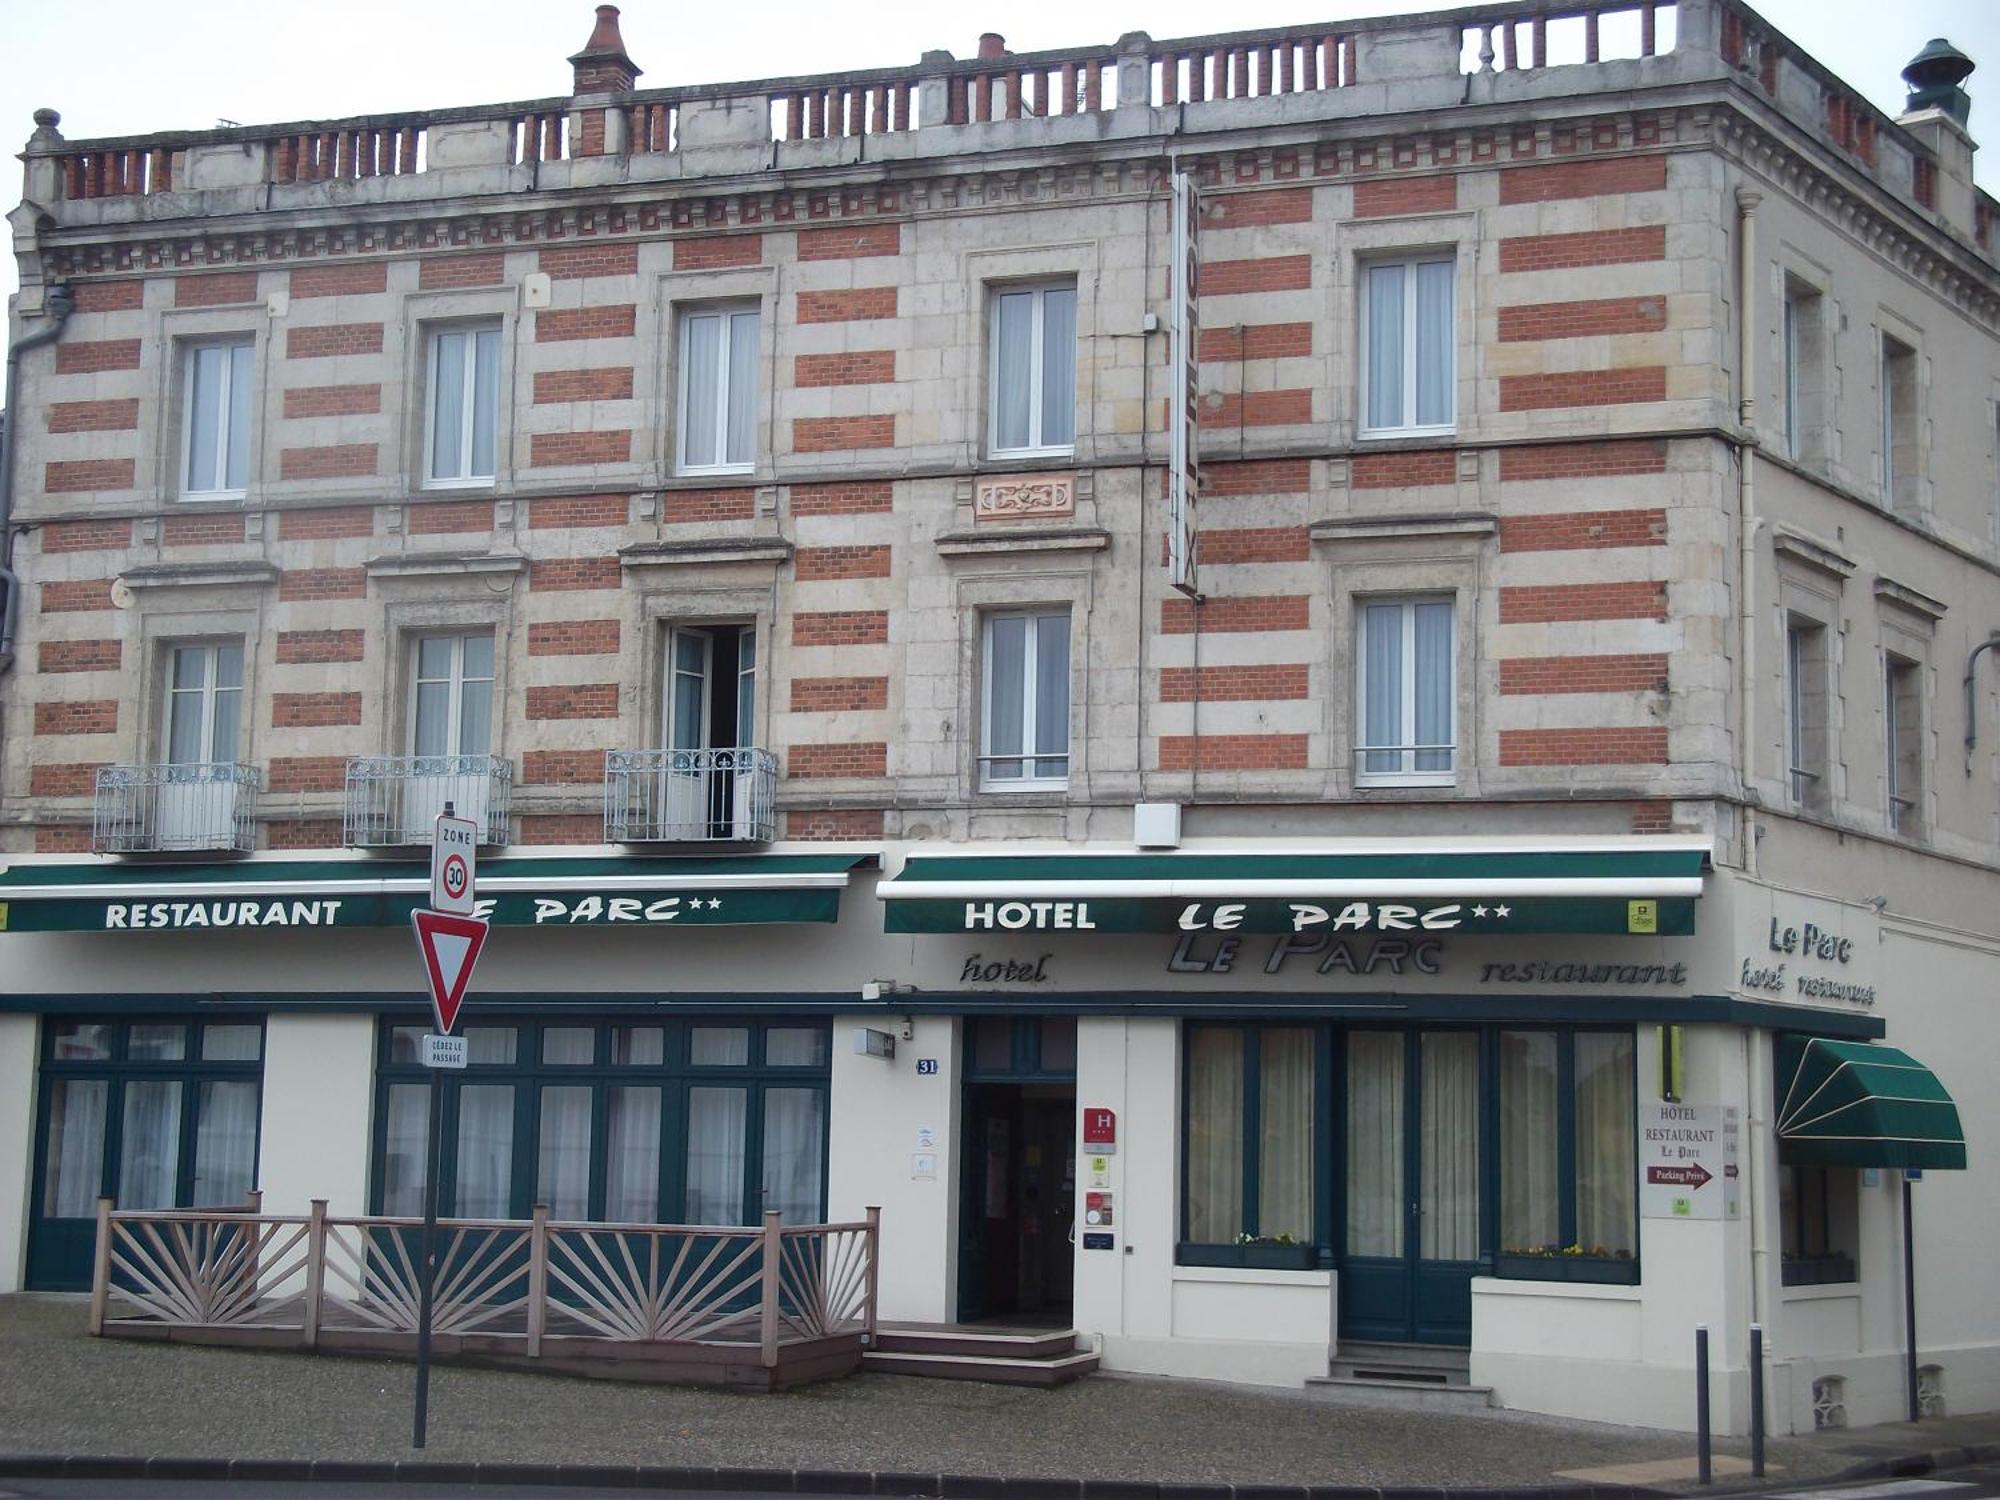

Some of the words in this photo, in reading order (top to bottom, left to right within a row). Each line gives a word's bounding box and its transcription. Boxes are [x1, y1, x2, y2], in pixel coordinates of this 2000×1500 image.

[1186, 183, 1198, 481] HOTEL
[443, 829, 471, 845] ZONE
[448, 867, 463, 887] 30
[106, 901, 342, 928] RESTAURANT
[534, 896, 681, 923] PARC
[964, 902, 1096, 929] HOTEL
[1178, 903, 1248, 931] LE
[1289, 902, 1462, 932] PARC
[1769, 917, 1799, 954] Le
[1802, 922, 1854, 964] Parc
[960, 953, 1053, 983] hotel
[1480, 961, 1688, 985] restaurant
[453, 1042, 462, 1051] LE
[432, 1054, 461, 1063] PASSAGE
[919, 1060, 935, 1073] 31
[1097, 1114, 1111, 1128] H
[1645, 1128, 1715, 1142] RESTAURANT
[1660, 1146, 1673, 1157] Le
[1678, 1145, 1701, 1159] Parc
[1656, 1170, 1685, 1183] Parking
